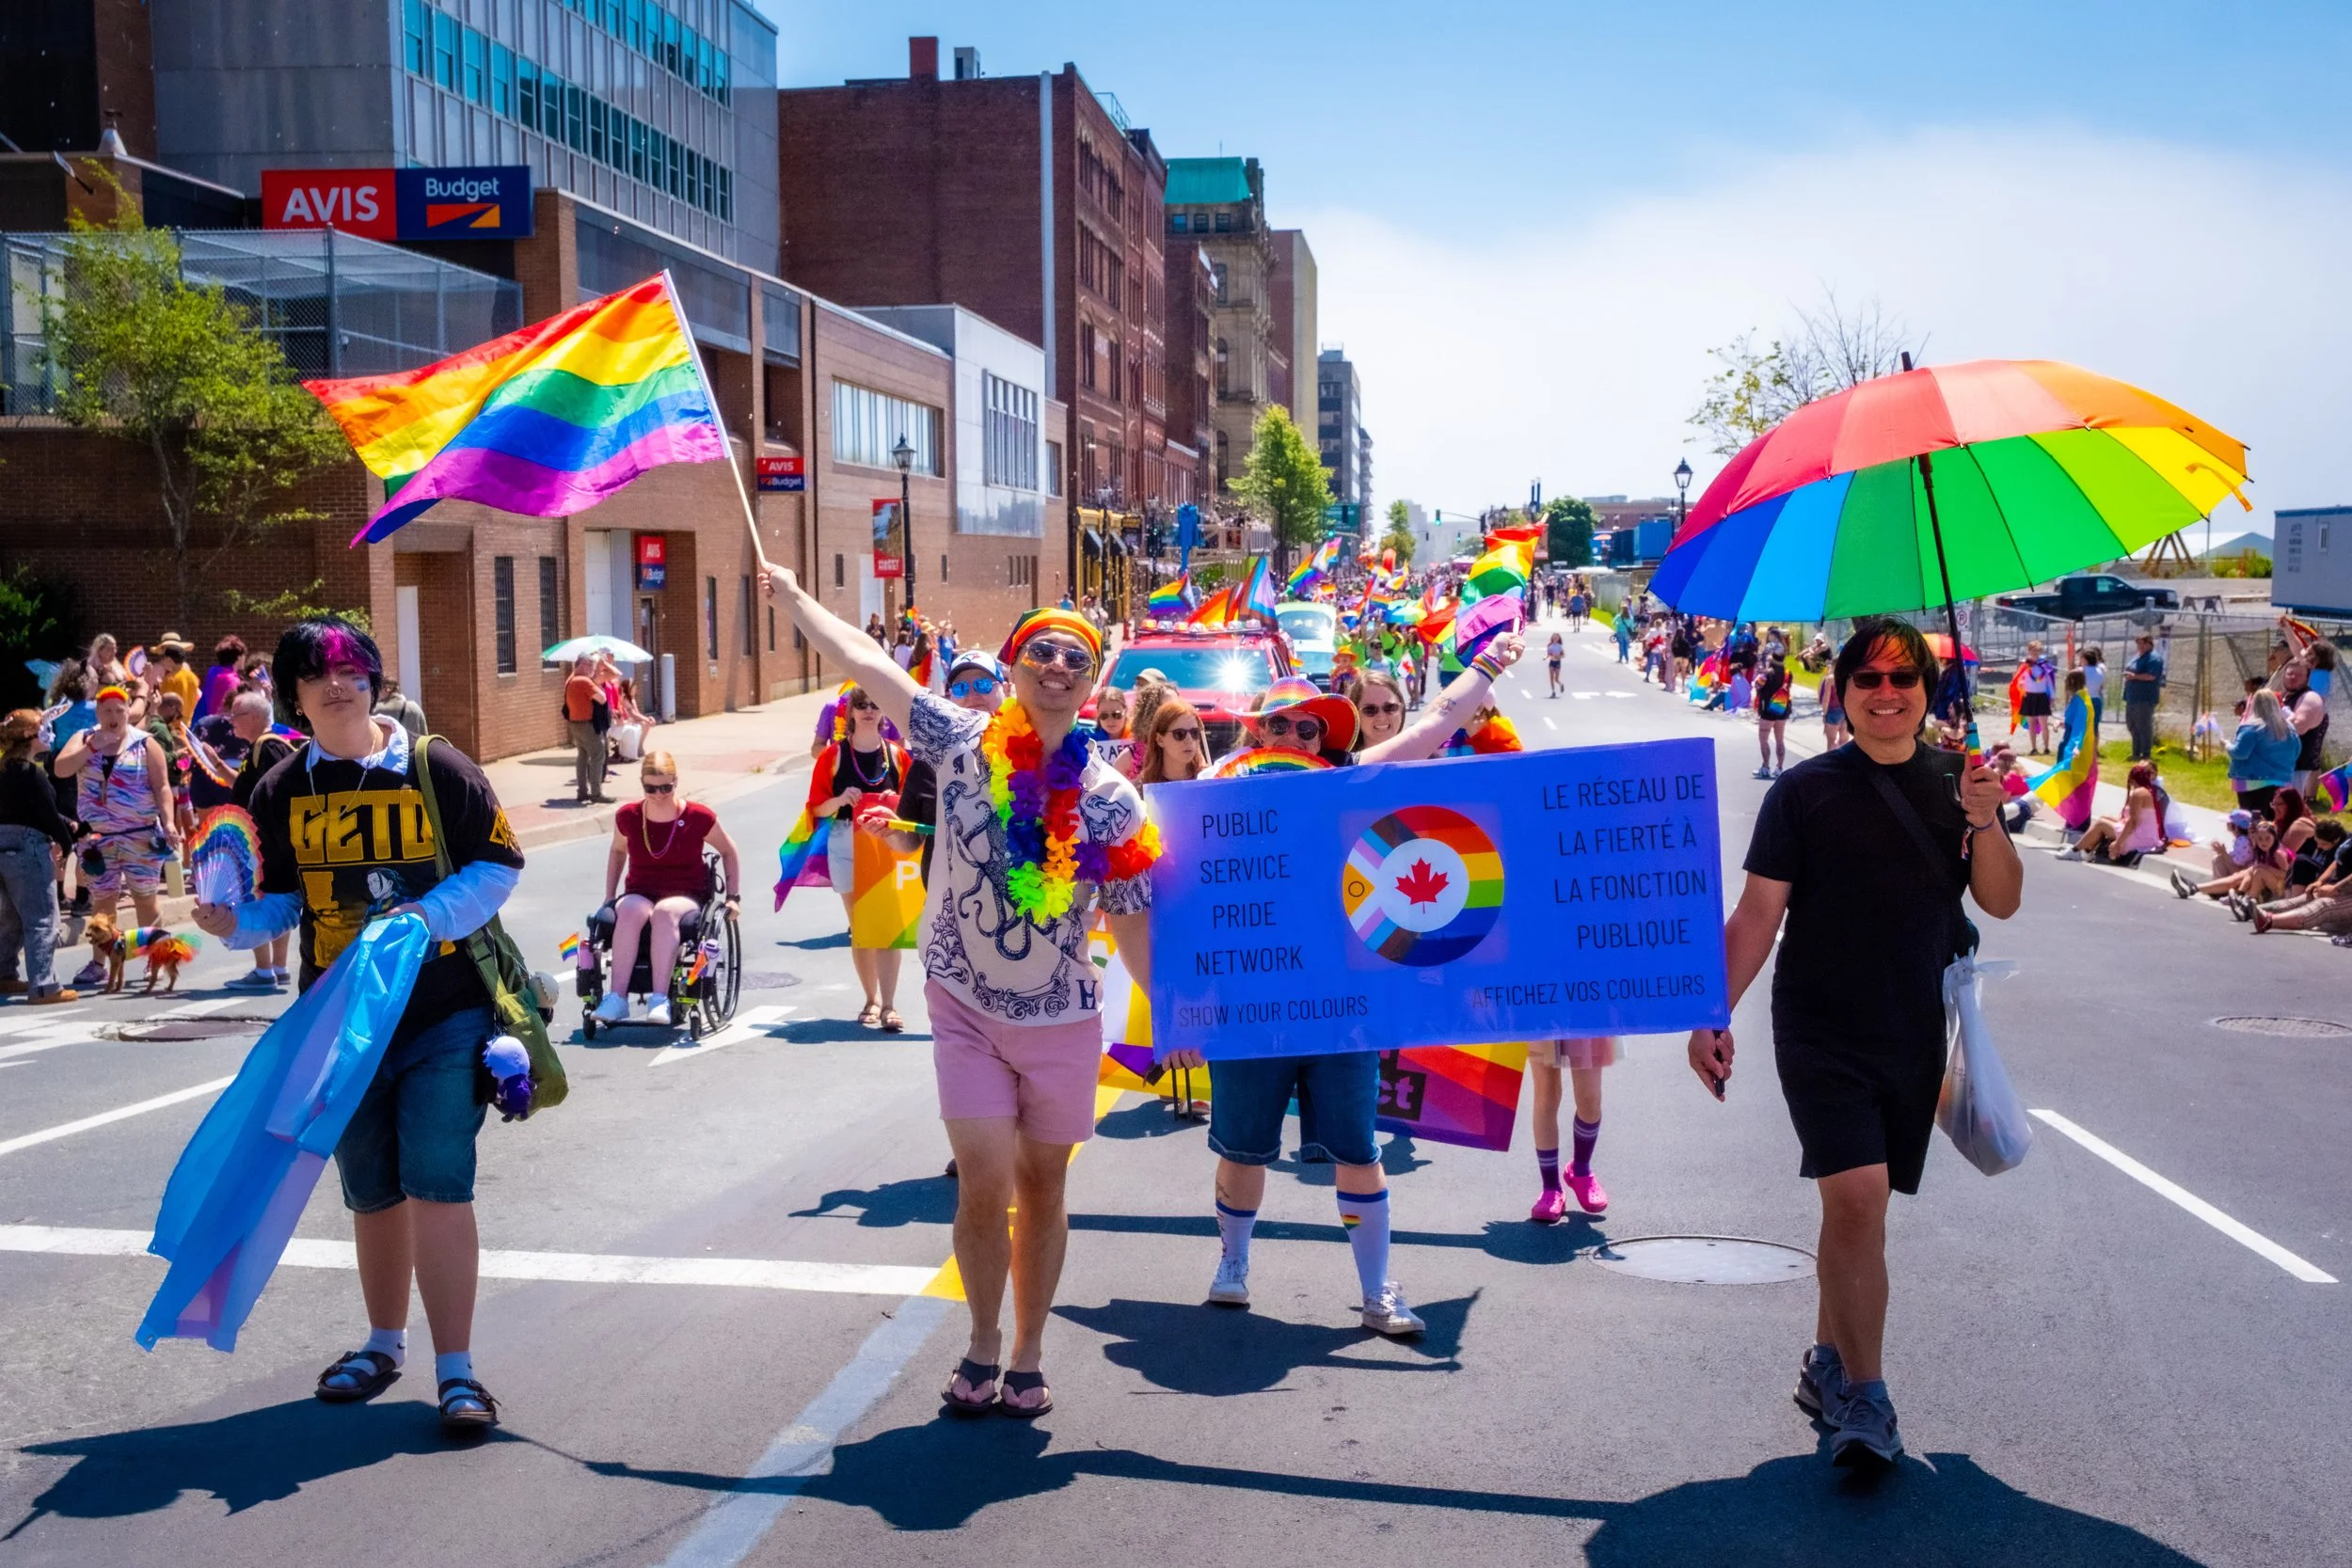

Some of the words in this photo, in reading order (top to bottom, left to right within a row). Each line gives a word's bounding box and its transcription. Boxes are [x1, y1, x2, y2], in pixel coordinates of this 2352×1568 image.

[282, 186, 379, 222] AVIS
[425, 177, 500, 202] Budget
[769, 462, 794, 471] AVIS
[1543, 784, 1570, 811] LE
[1578, 776, 1666, 808] RÉSEAU
[1676, 774, 1706, 800] DE
[1201, 809, 1279, 839] PUBLIC
[1559, 831, 1587, 857] LA
[1595, 817, 1675, 854] FIERTÉ
[1682, 816, 1697, 848] À
[1200, 854, 1292, 885] SERVICE
[1554, 878, 1583, 904] LA
[1591, 869, 1707, 902] FONCTION
[1212, 901, 1277, 930] PRIDE
[1577, 918, 1691, 950] PUBLIQUE
[1196, 945, 1304, 976] NETWORK
[1472, 983, 1559, 1009] AFFICHEZ
[1565, 980, 1600, 1003] VOS
[1607, 974, 1706, 1001] COULEURS
[1179, 1005, 1229, 1028] SHOW
[1237, 1002, 1281, 1024] YOUR
[1287, 995, 1368, 1022] COLOURS
